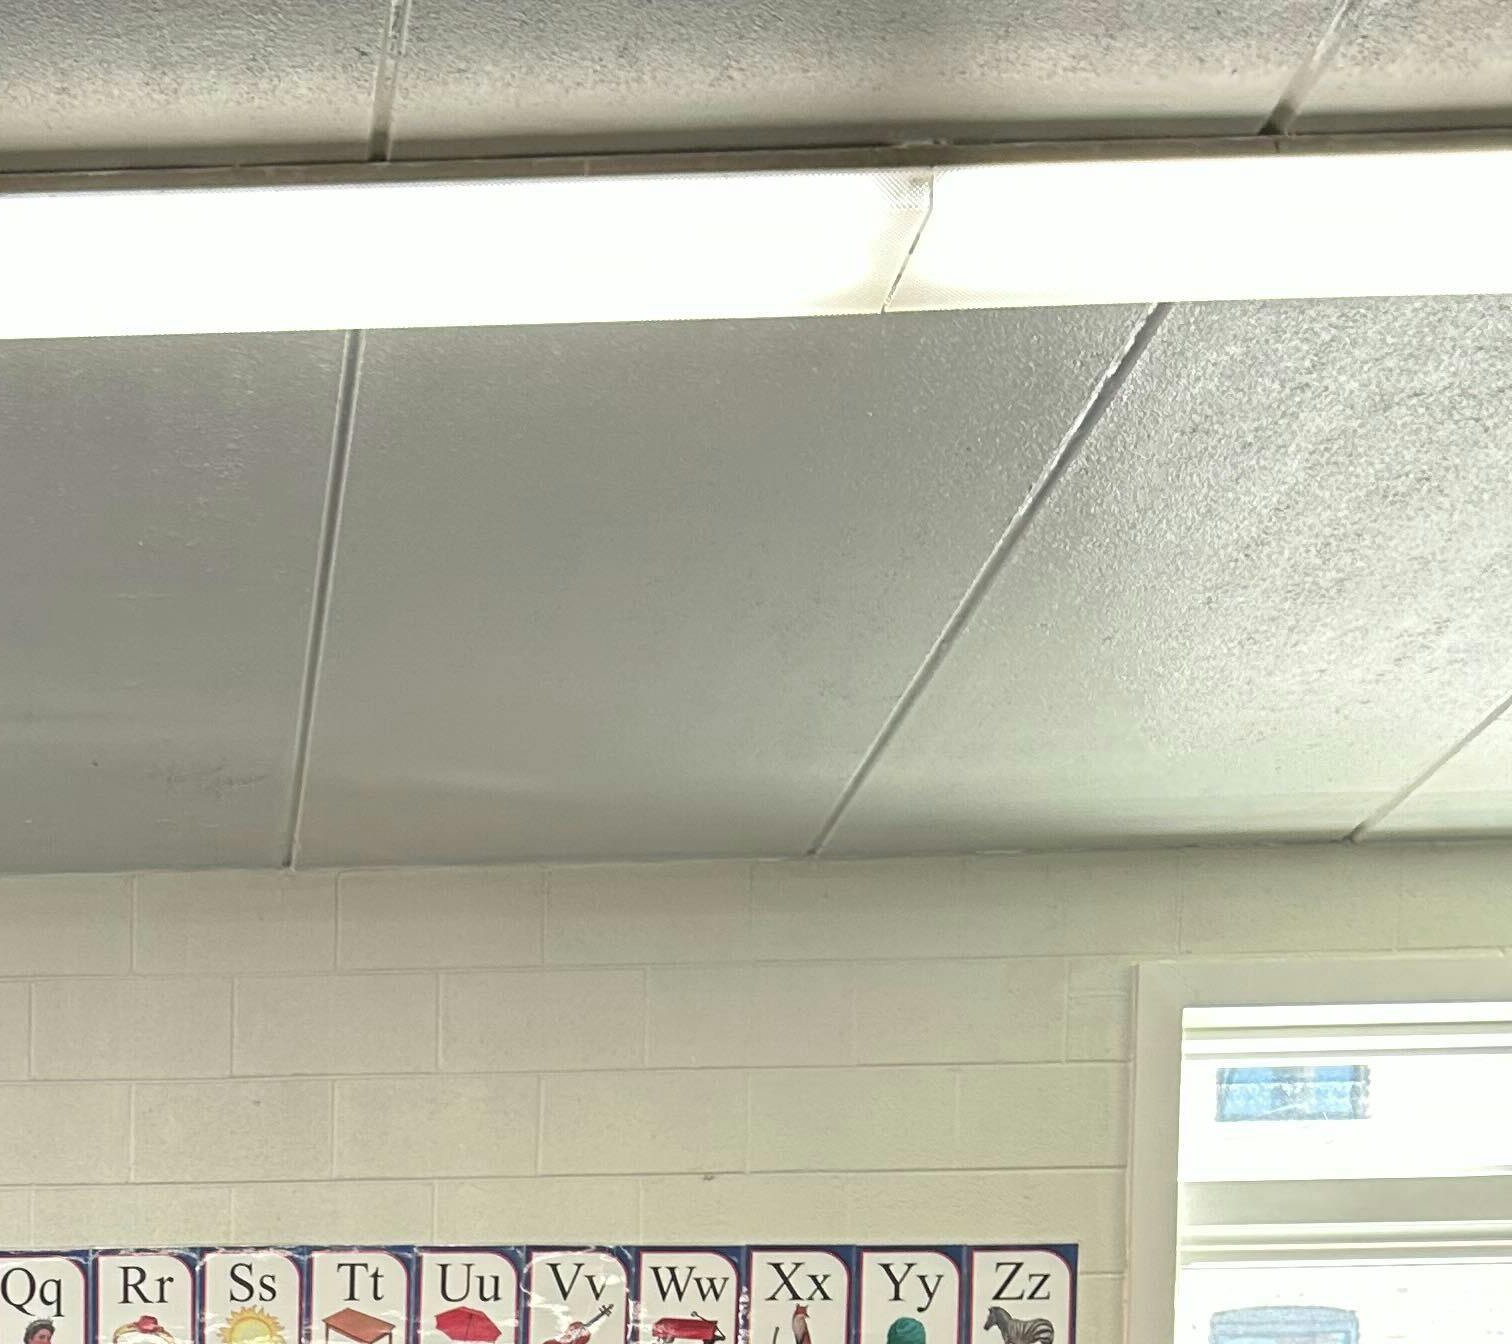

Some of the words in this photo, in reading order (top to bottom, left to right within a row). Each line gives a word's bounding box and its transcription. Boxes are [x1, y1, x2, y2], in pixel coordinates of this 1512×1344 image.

[0, 1267, 63, 1318] Qq
[118, 1265, 175, 1305] Rr
[228, 1263, 277, 1304] Ss
[336, 1262, 385, 1301] Tt
[439, 1262, 503, 1303] Uu
[549, 1262, 609, 1302] Vv
[650, 1262, 730, 1303] Ww
[766, 1261, 832, 1302] Xx
[878, 1262, 944, 1313] Yy
[994, 1261, 1051, 1301] Zz
